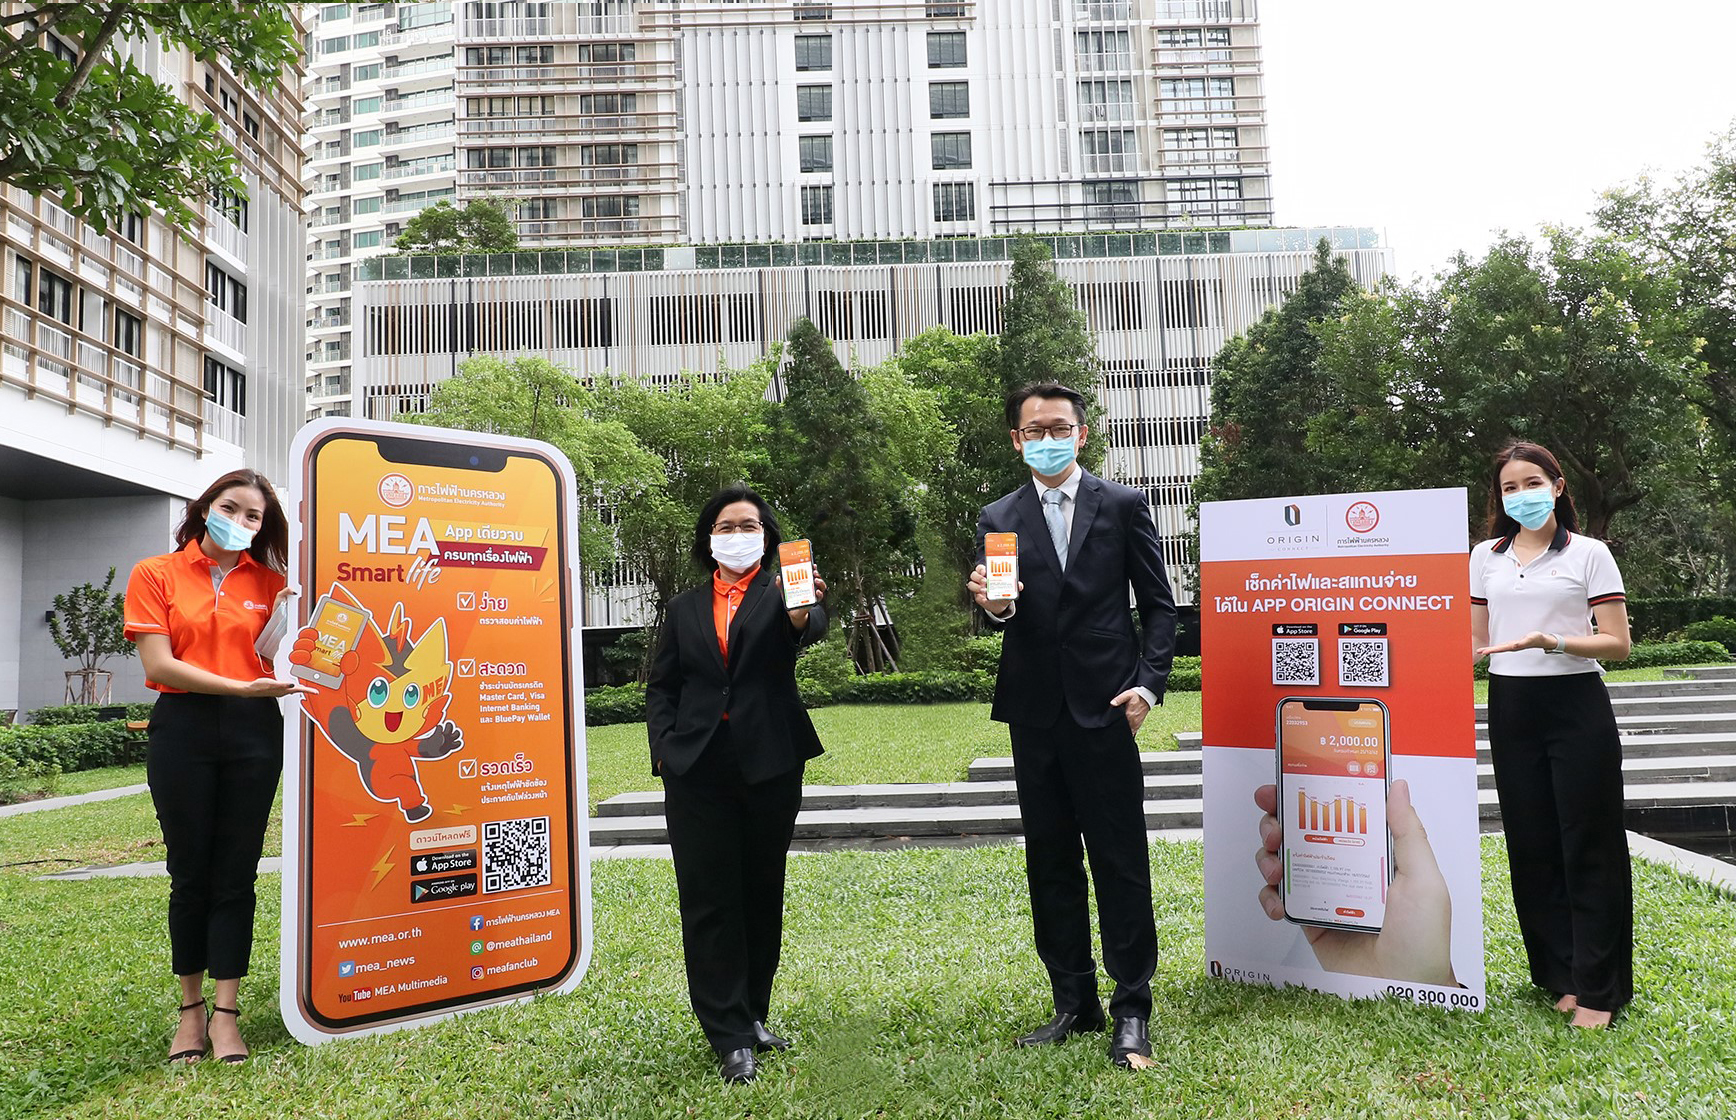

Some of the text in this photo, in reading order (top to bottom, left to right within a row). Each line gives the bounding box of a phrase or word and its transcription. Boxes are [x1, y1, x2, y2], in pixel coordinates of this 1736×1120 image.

[418, 483, 506, 501] การไฟฟ้านครหลวง
[418, 495, 505, 508] Metropolitan Electricity Authority
[339, 512, 441, 556] MEA
[445, 525, 524, 542] App เดียวจบ
[1267, 535, 1320, 545] ORIGIN
[444, 547, 533, 566] ครบทุกเรื่องไฟฟ้า
[337, 556, 442, 591] Smart life
[1245, 569, 1417, 592] เช็กค่าไฟและสแกนจ่าย
[479, 592, 508, 611] ง่าย
[1214, 595, 1454, 613] ได้ใน APP ORIGIN CONNECT
[479, 616, 543, 626] ตรวจสอบค่าไฟฟ้า
[479, 661, 527, 676] สะดวก
[479, 691, 546, 702] Master Card, Visa
[480, 703, 541, 713] Internet Banking
[480, 713, 552, 724] และ BluePay Wallet
[1329, 735, 1378, 748] 2,000.00
[480, 752, 533, 776] รวดเร็ว
[416, 830, 471, 844] ดาวน์โหลดฟรี
[431, 859, 472, 871] App Store
[430, 882, 476, 895] Google play
[485, 908, 560, 927] การไฟฟ้านครหลวง MEA
[338, 927, 423, 949] www.mea.or.th
[486, 931, 553, 952] @meathailand
[355, 956, 416, 974] mea_news
[486, 957, 539, 976] meafanclub
[1224, 967, 1270, 981] ORIGIN
[374, 985, 396, 997] MEA
[397, 975, 448, 992] Multimedia
[1418, 989, 1446, 1003] 300
[1450, 993, 1479, 1008] 000
